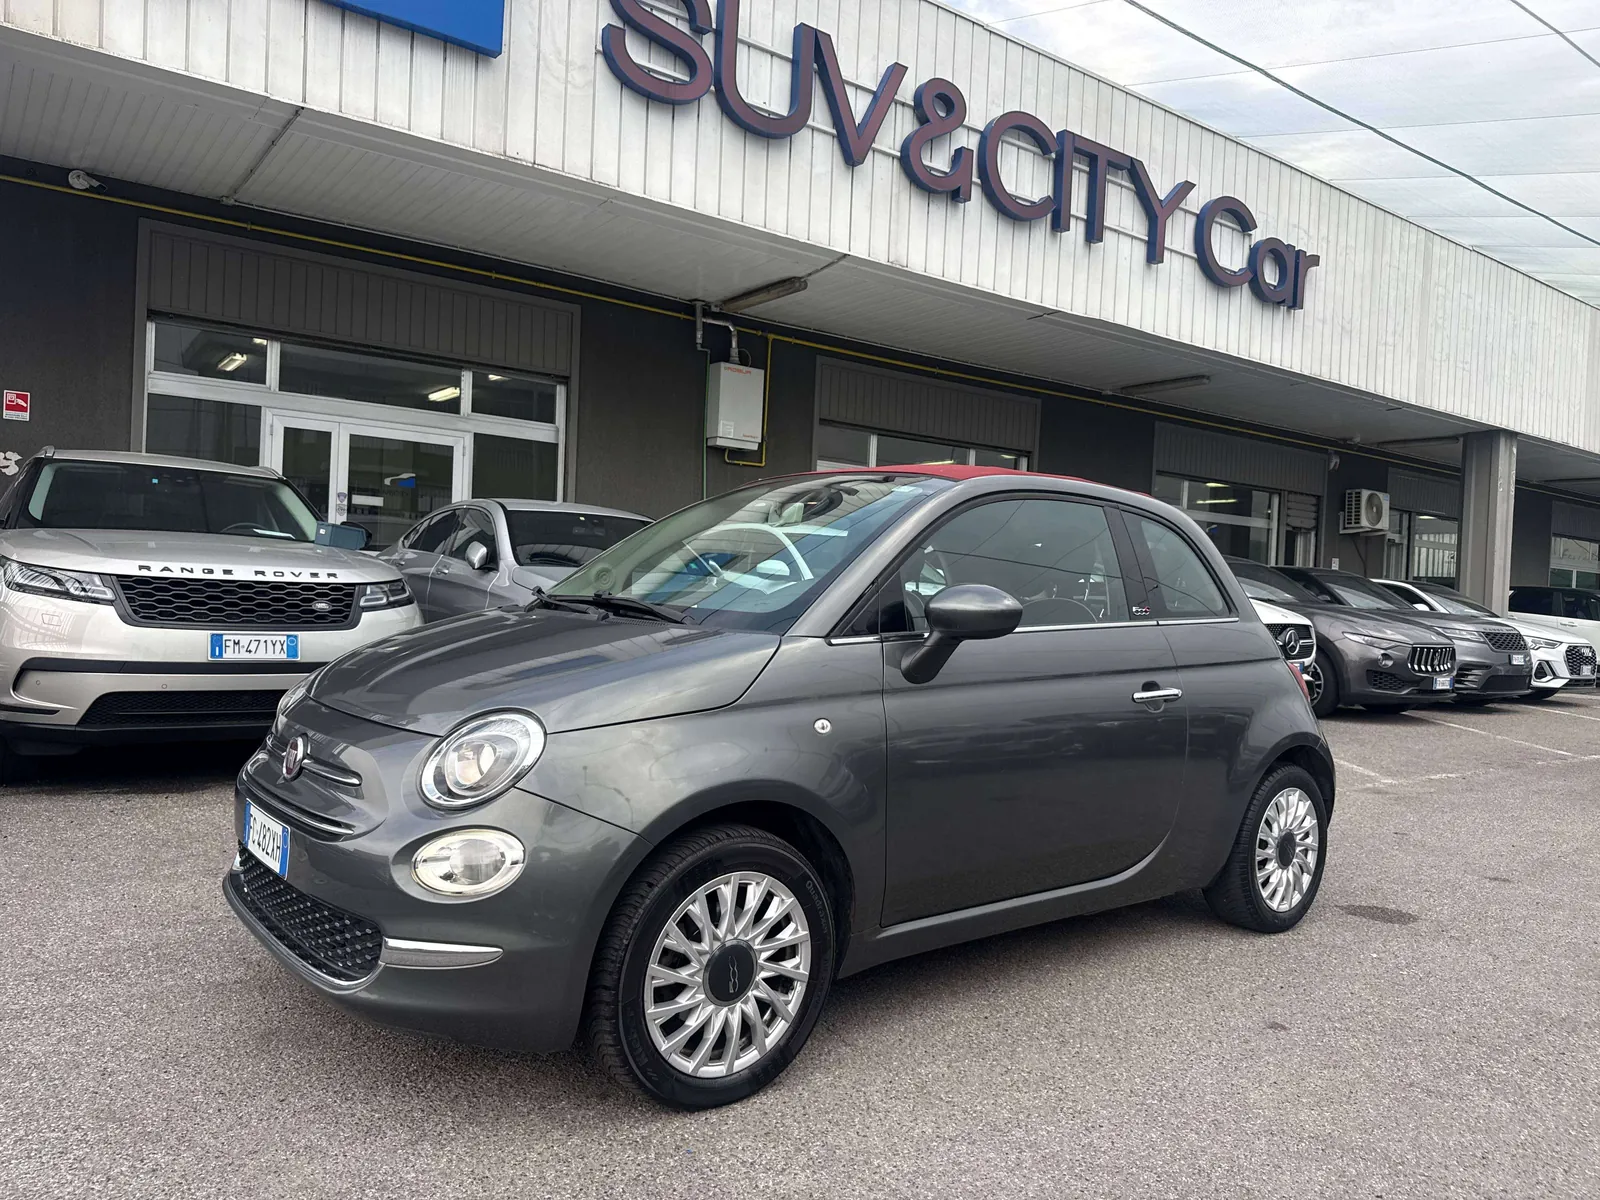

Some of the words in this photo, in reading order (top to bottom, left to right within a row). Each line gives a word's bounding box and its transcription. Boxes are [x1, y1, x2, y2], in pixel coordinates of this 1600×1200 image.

[1195, 196, 1320, 310] Car
[138, 565, 234, 576] RANGE
[254, 570, 339, 579] ROVER
